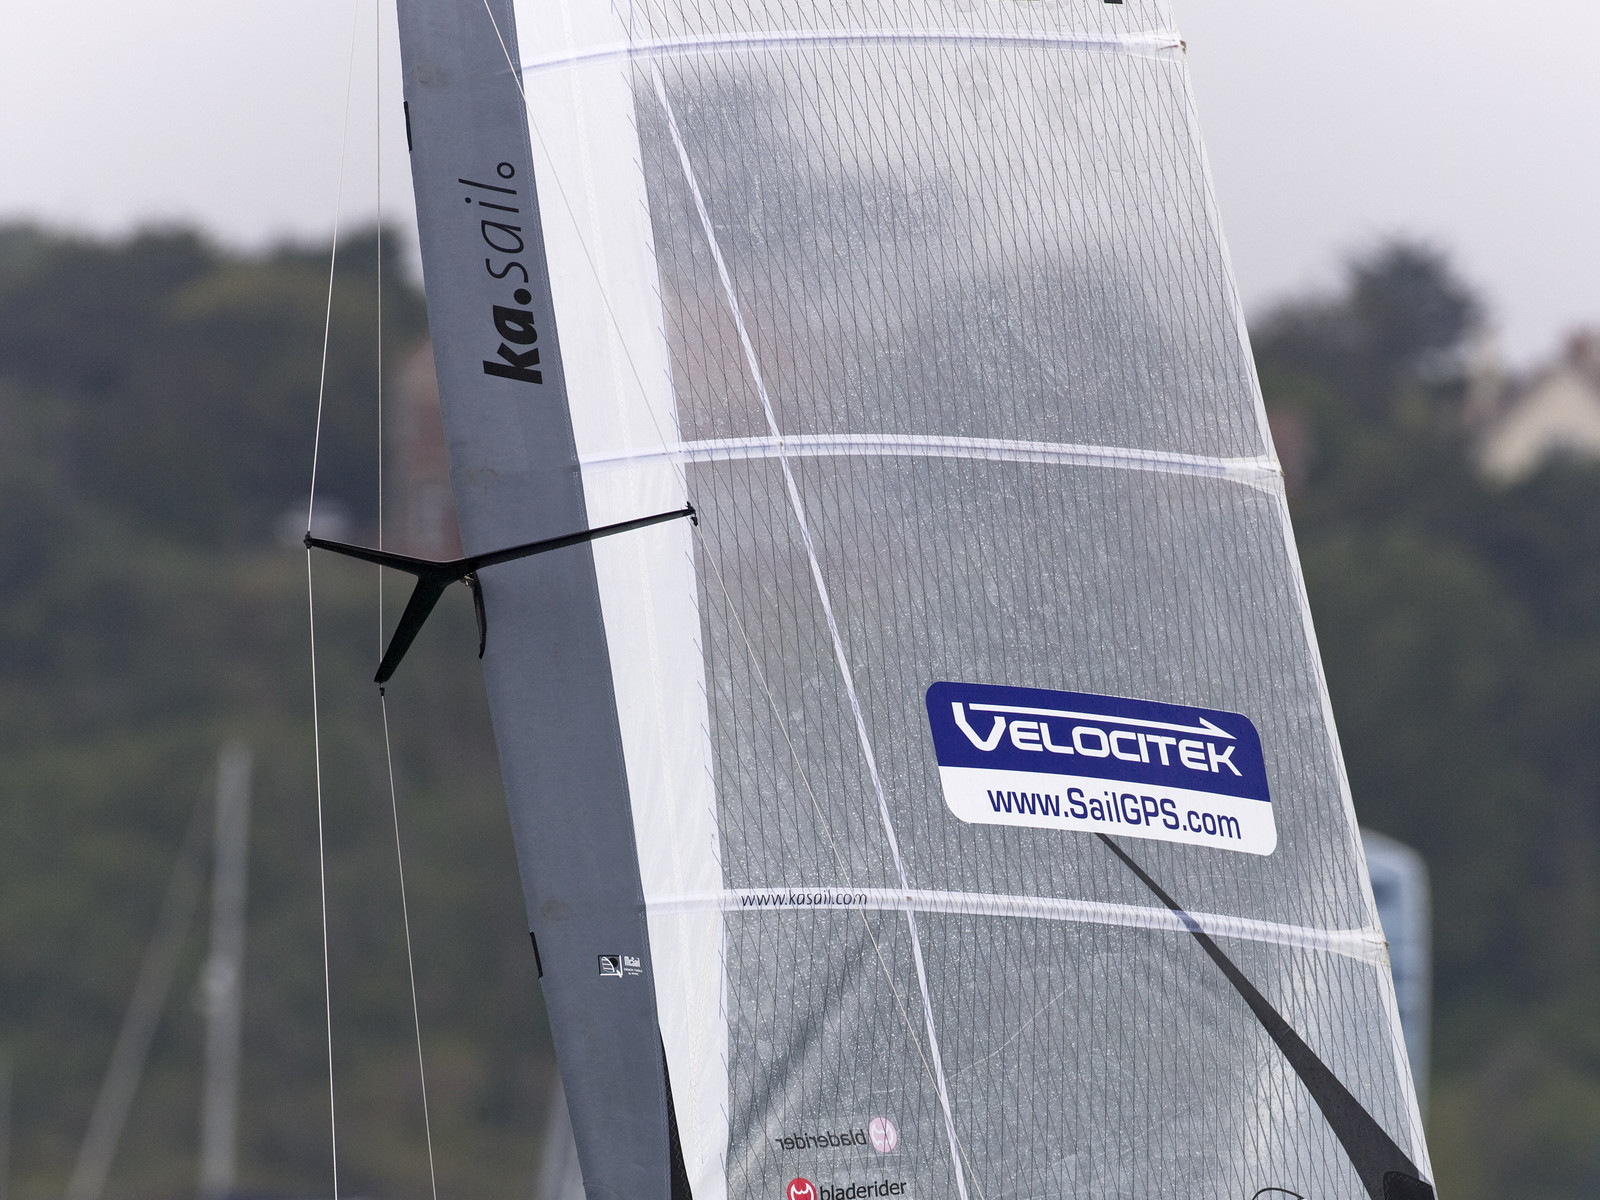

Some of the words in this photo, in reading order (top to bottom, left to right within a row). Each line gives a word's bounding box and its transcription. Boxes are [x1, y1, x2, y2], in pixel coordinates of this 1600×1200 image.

[951, 701, 1242, 776] VELOCITEK
[987, 787, 1242, 839] www.SailGPS.com
[740, 889, 868, 906] www.kasail.com
